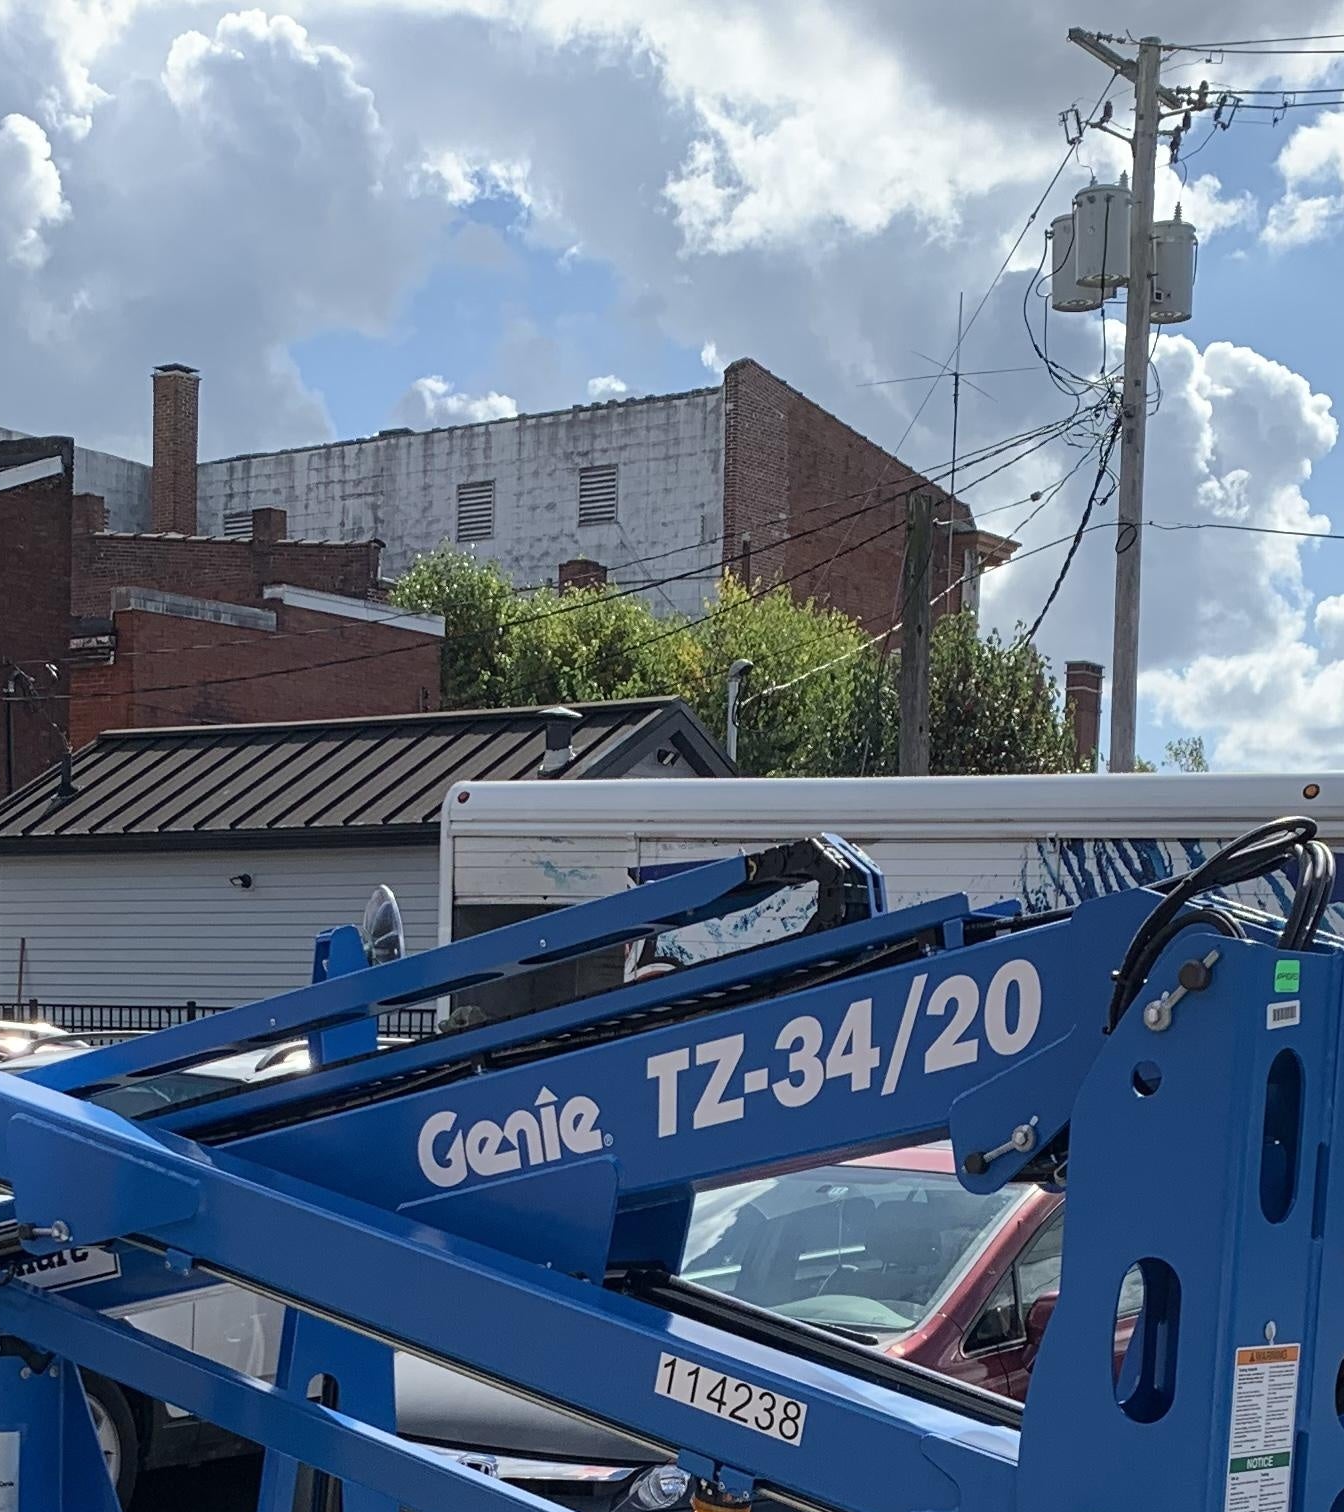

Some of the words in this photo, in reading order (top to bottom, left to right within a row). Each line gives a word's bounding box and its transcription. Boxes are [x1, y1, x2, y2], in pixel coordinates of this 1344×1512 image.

[417, 1085, 603, 1188] Genie
[646, 958, 1043, 1139] TZ-34/20
[1255, 1348, 1288, 1361] WARNING
[663, 1357, 802, 1441] 114238
[1245, 1455, 1274, 1471] NOTICE
